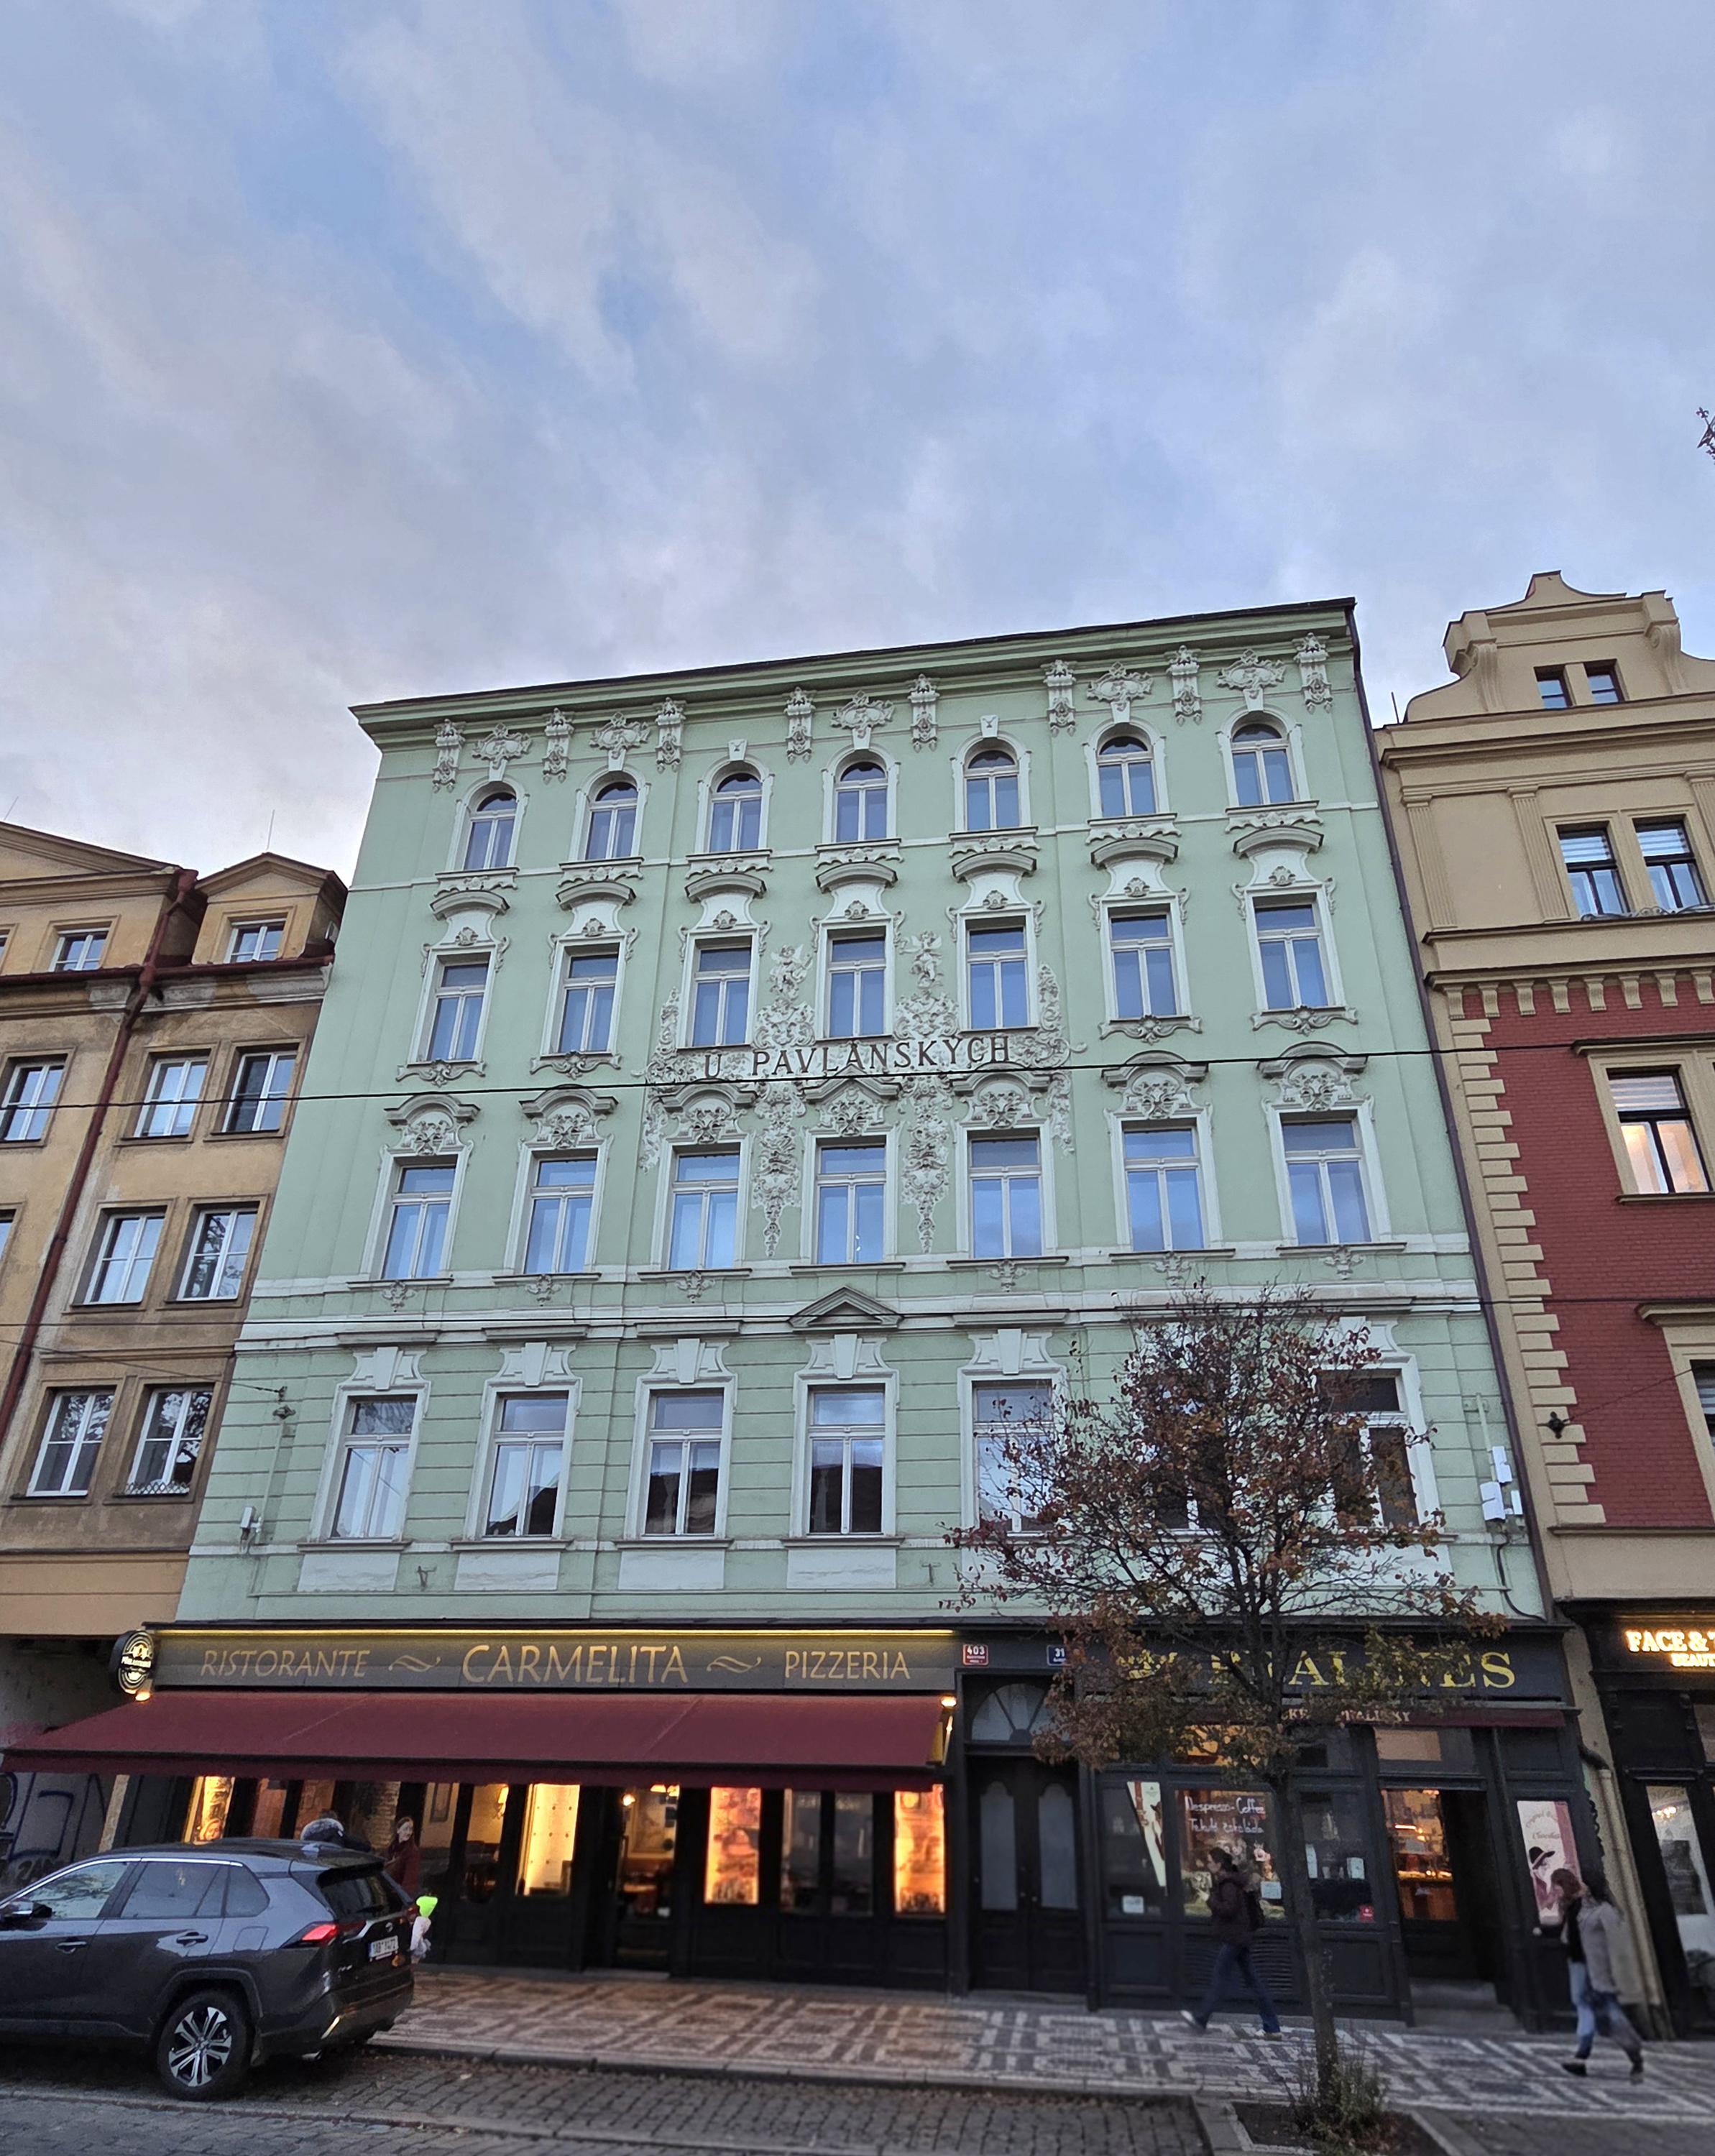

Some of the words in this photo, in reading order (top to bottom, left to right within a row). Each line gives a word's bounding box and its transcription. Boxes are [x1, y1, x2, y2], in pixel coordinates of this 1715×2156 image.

[704, 1054, 722, 1079] U
[967, 1645, 985, 1655] 403
[1625, 1630, 1688, 1652] FACE
[201, 1649, 371, 1677] RISTORANTE
[462, 1644, 689, 1683] CARMELITA
[784, 1650, 911, 1680] PIZZERIA
